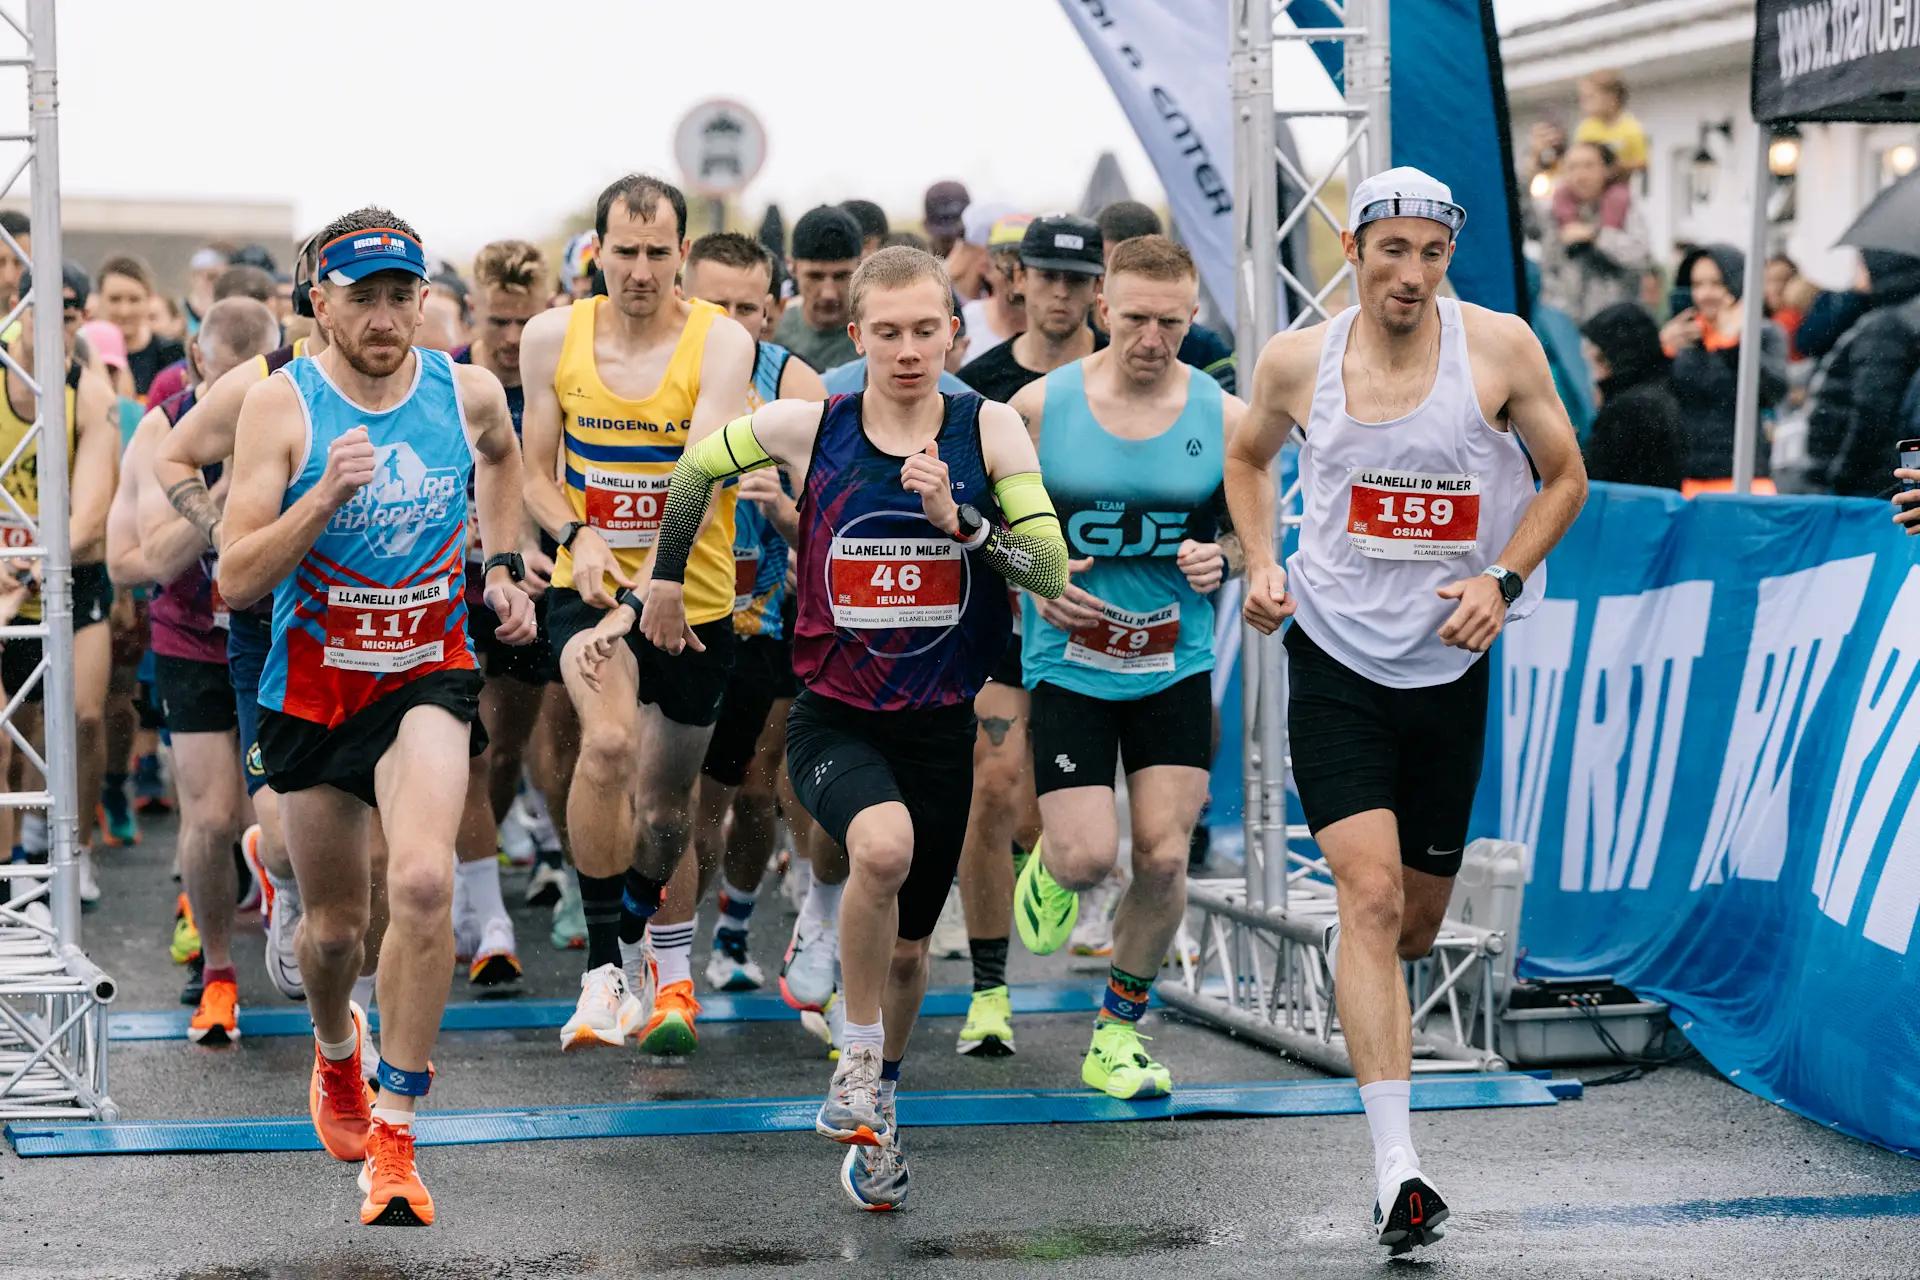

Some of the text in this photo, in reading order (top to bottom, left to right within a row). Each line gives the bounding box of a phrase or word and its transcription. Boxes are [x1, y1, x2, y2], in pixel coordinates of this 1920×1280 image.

[578, 416, 690, 433] BRIDGEND A C
[592, 474, 635, 488] LLANELLI
[638, 480, 647, 489] 10
[1362, 473, 1471, 491] LLANELLI 10 MILER
[613, 494, 657, 518] 20
[1095, 501, 1126, 511] TEAM
[1377, 496, 1454, 526] 159
[1392, 527, 1433, 538] OSIAN
[842, 545, 951, 556] LLANELLI 10 MILER
[870, 565, 922, 592] 46
[338, 586, 440, 605] LLANELLI 10 MILER
[876, 596, 916, 605] IEUAN
[355, 607, 428, 637] 117
[1100, 604, 1134, 625] ANELLI
[1147, 608, 1173, 622] MILER
[362, 638, 416, 650] MICHAEL
[1107, 625, 1149, 649] 79
[1106, 645, 1141, 658] SIMON
